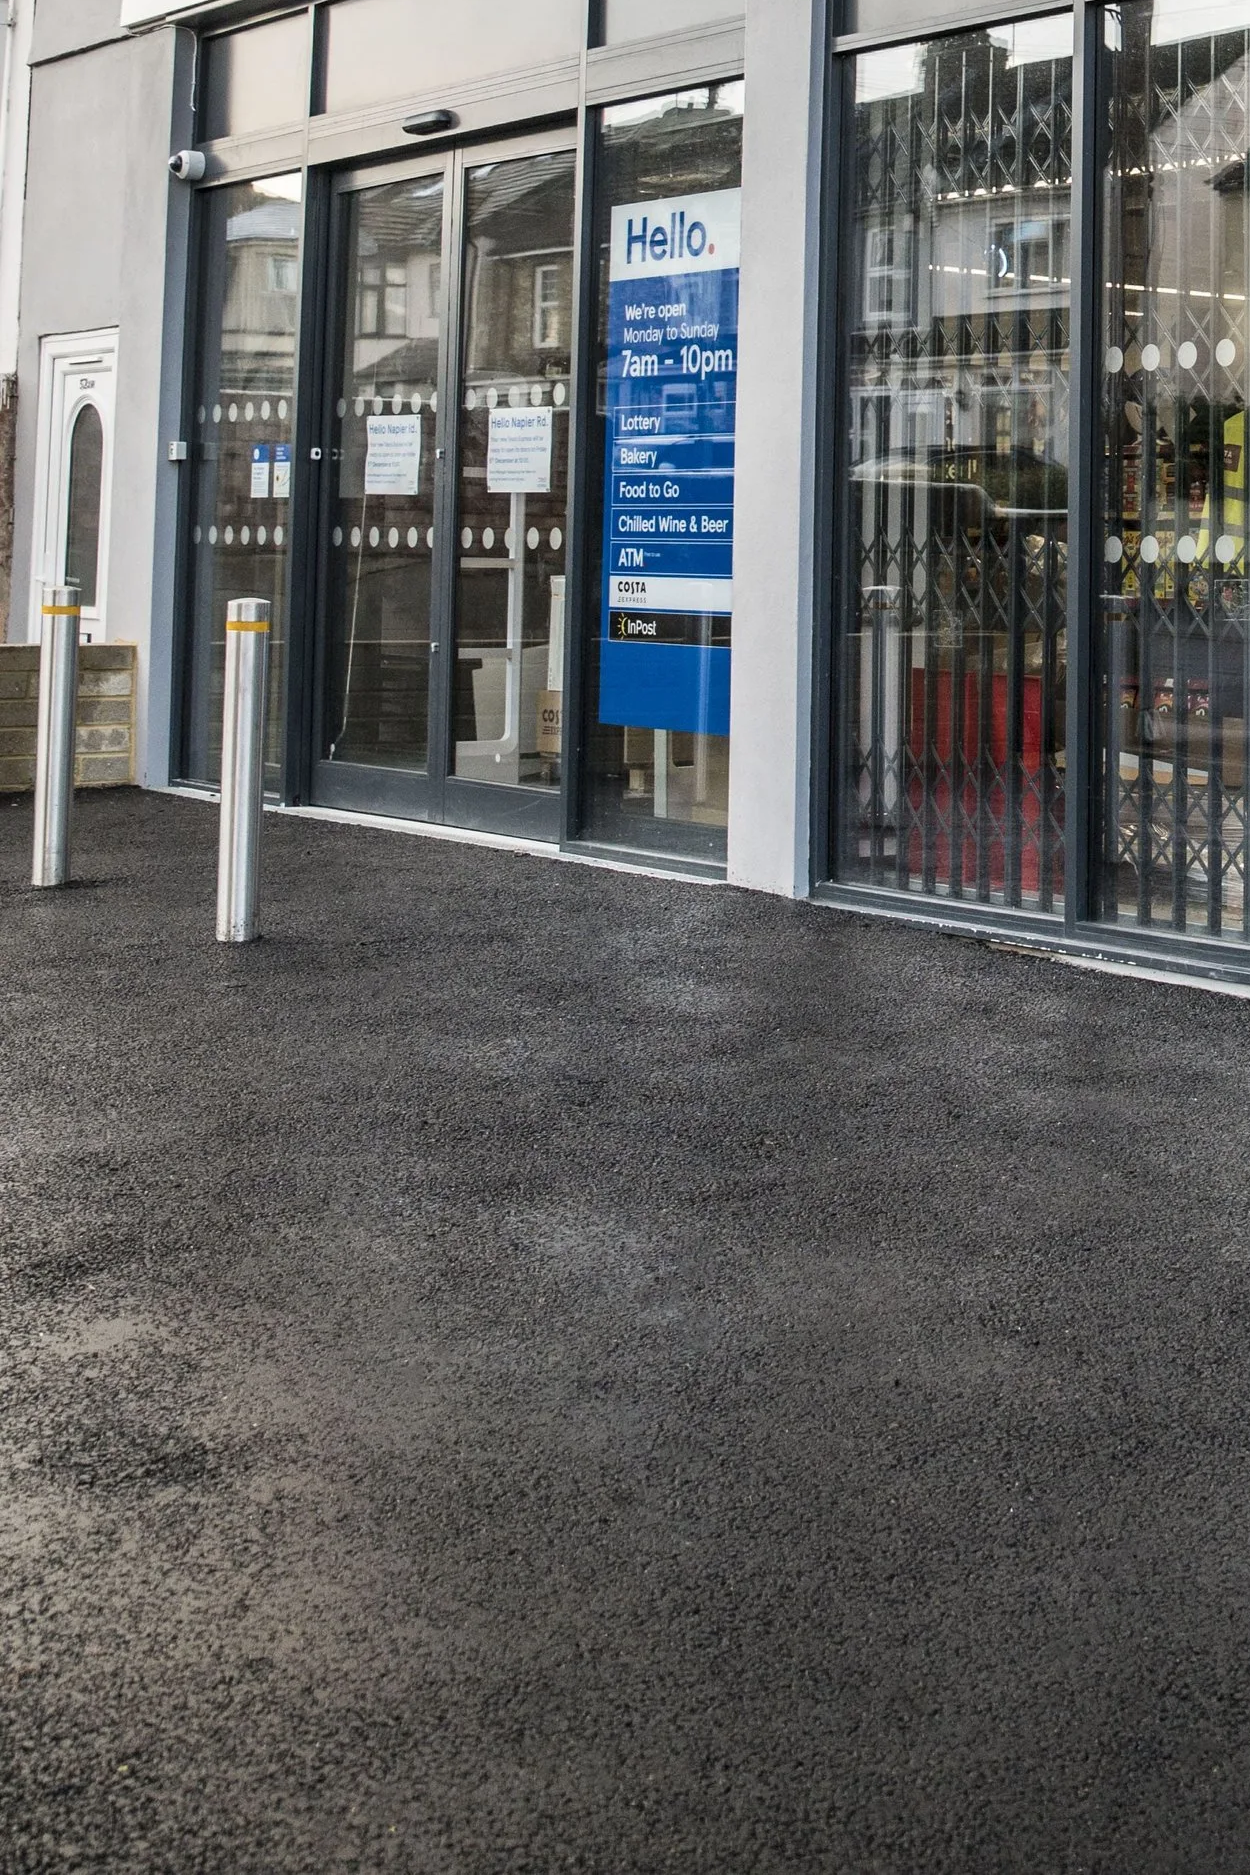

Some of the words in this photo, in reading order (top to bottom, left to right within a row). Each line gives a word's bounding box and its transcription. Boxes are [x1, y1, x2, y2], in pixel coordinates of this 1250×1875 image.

[626, 210, 716, 265] Hello.
[657, 301, 687, 323] open
[623, 325, 664, 345] Monday
[666, 326, 678, 341] to
[680, 321, 720, 342] Sunday
[621, 349, 658, 378] 7am
[679, 344, 733, 380] 10pm
[491, 417, 509, 429] Hello
[511, 416, 535, 430] Napier
[620, 413, 661, 434] Lottery
[619, 447, 658, 468] Bakery
[619, 481, 646, 499] Food
[648, 482, 661, 499] to
[662, 480, 680, 499] Go
[618, 515, 656, 533] Chilled
[658, 515, 687, 533] Wine
[689, 516, 698, 534] &
[700, 516, 729, 534] Beer
[617, 581, 647, 595] COSTA
[627, 619, 657, 636] InPost
